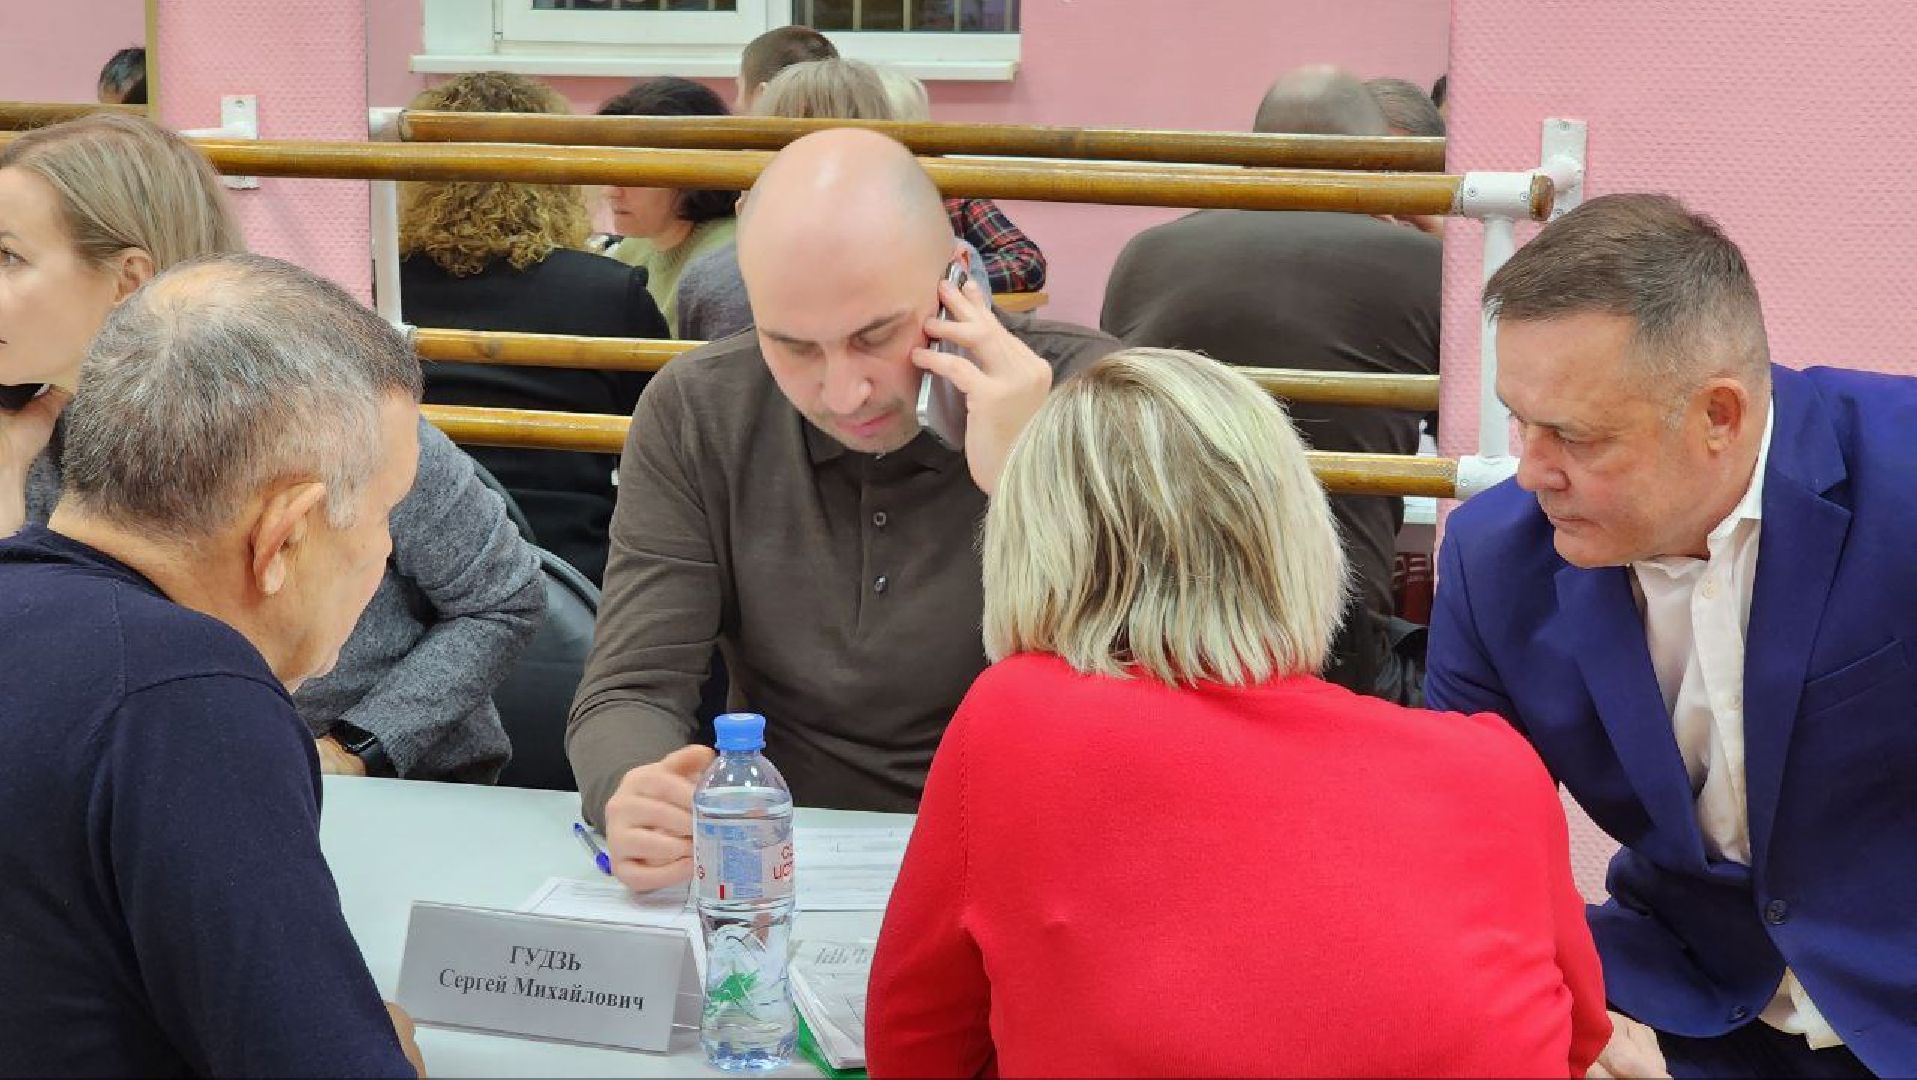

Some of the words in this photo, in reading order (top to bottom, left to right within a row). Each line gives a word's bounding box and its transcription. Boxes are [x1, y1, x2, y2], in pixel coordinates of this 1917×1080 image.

[509, 945, 582, 971] ГУДЗЬ
[439, 968, 507, 994] Сергей
[512, 976, 645, 1010] Михайлович
